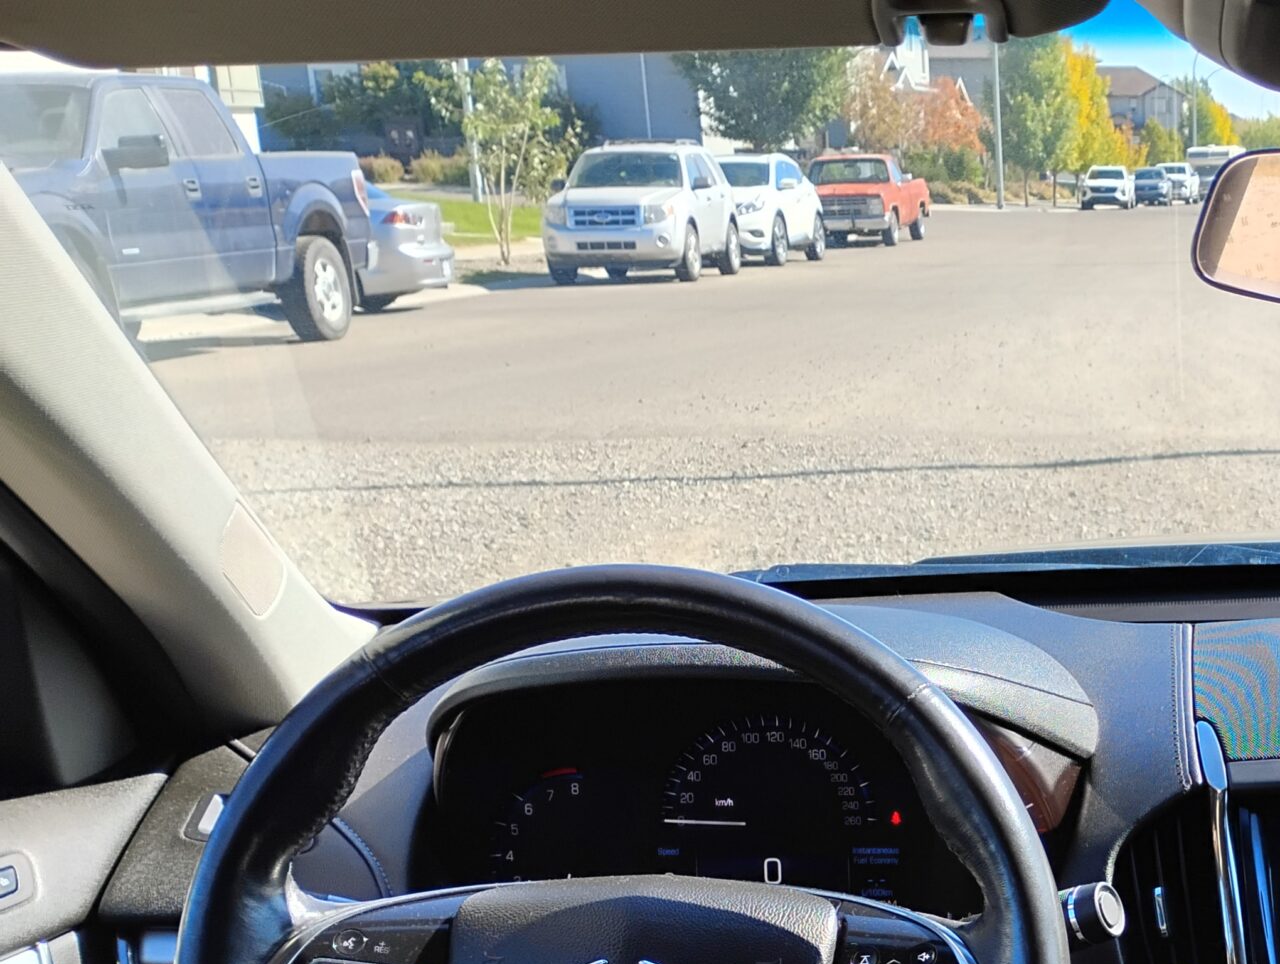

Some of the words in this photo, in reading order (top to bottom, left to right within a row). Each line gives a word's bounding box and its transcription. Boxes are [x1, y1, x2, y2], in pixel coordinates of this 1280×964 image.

[741, 733, 760, 744] 100
[766, 731, 785, 743] 120
[721, 741, 736, 752] 80
[789, 738, 807, 750] 140
[703, 754, 718, 765] 60
[807, 749, 827, 761] 160
[687, 771, 701, 782] 40
[571, 782, 580, 795] 8
[546, 789, 554, 801] 7
[680, 792, 694, 804] 20
[715, 798, 734, 807] km/h
[524, 803, 533, 815] 6
[510, 823, 519, 836] 5
[505, 850, 514, 862] 4
[763, 857, 782, 885] 0
